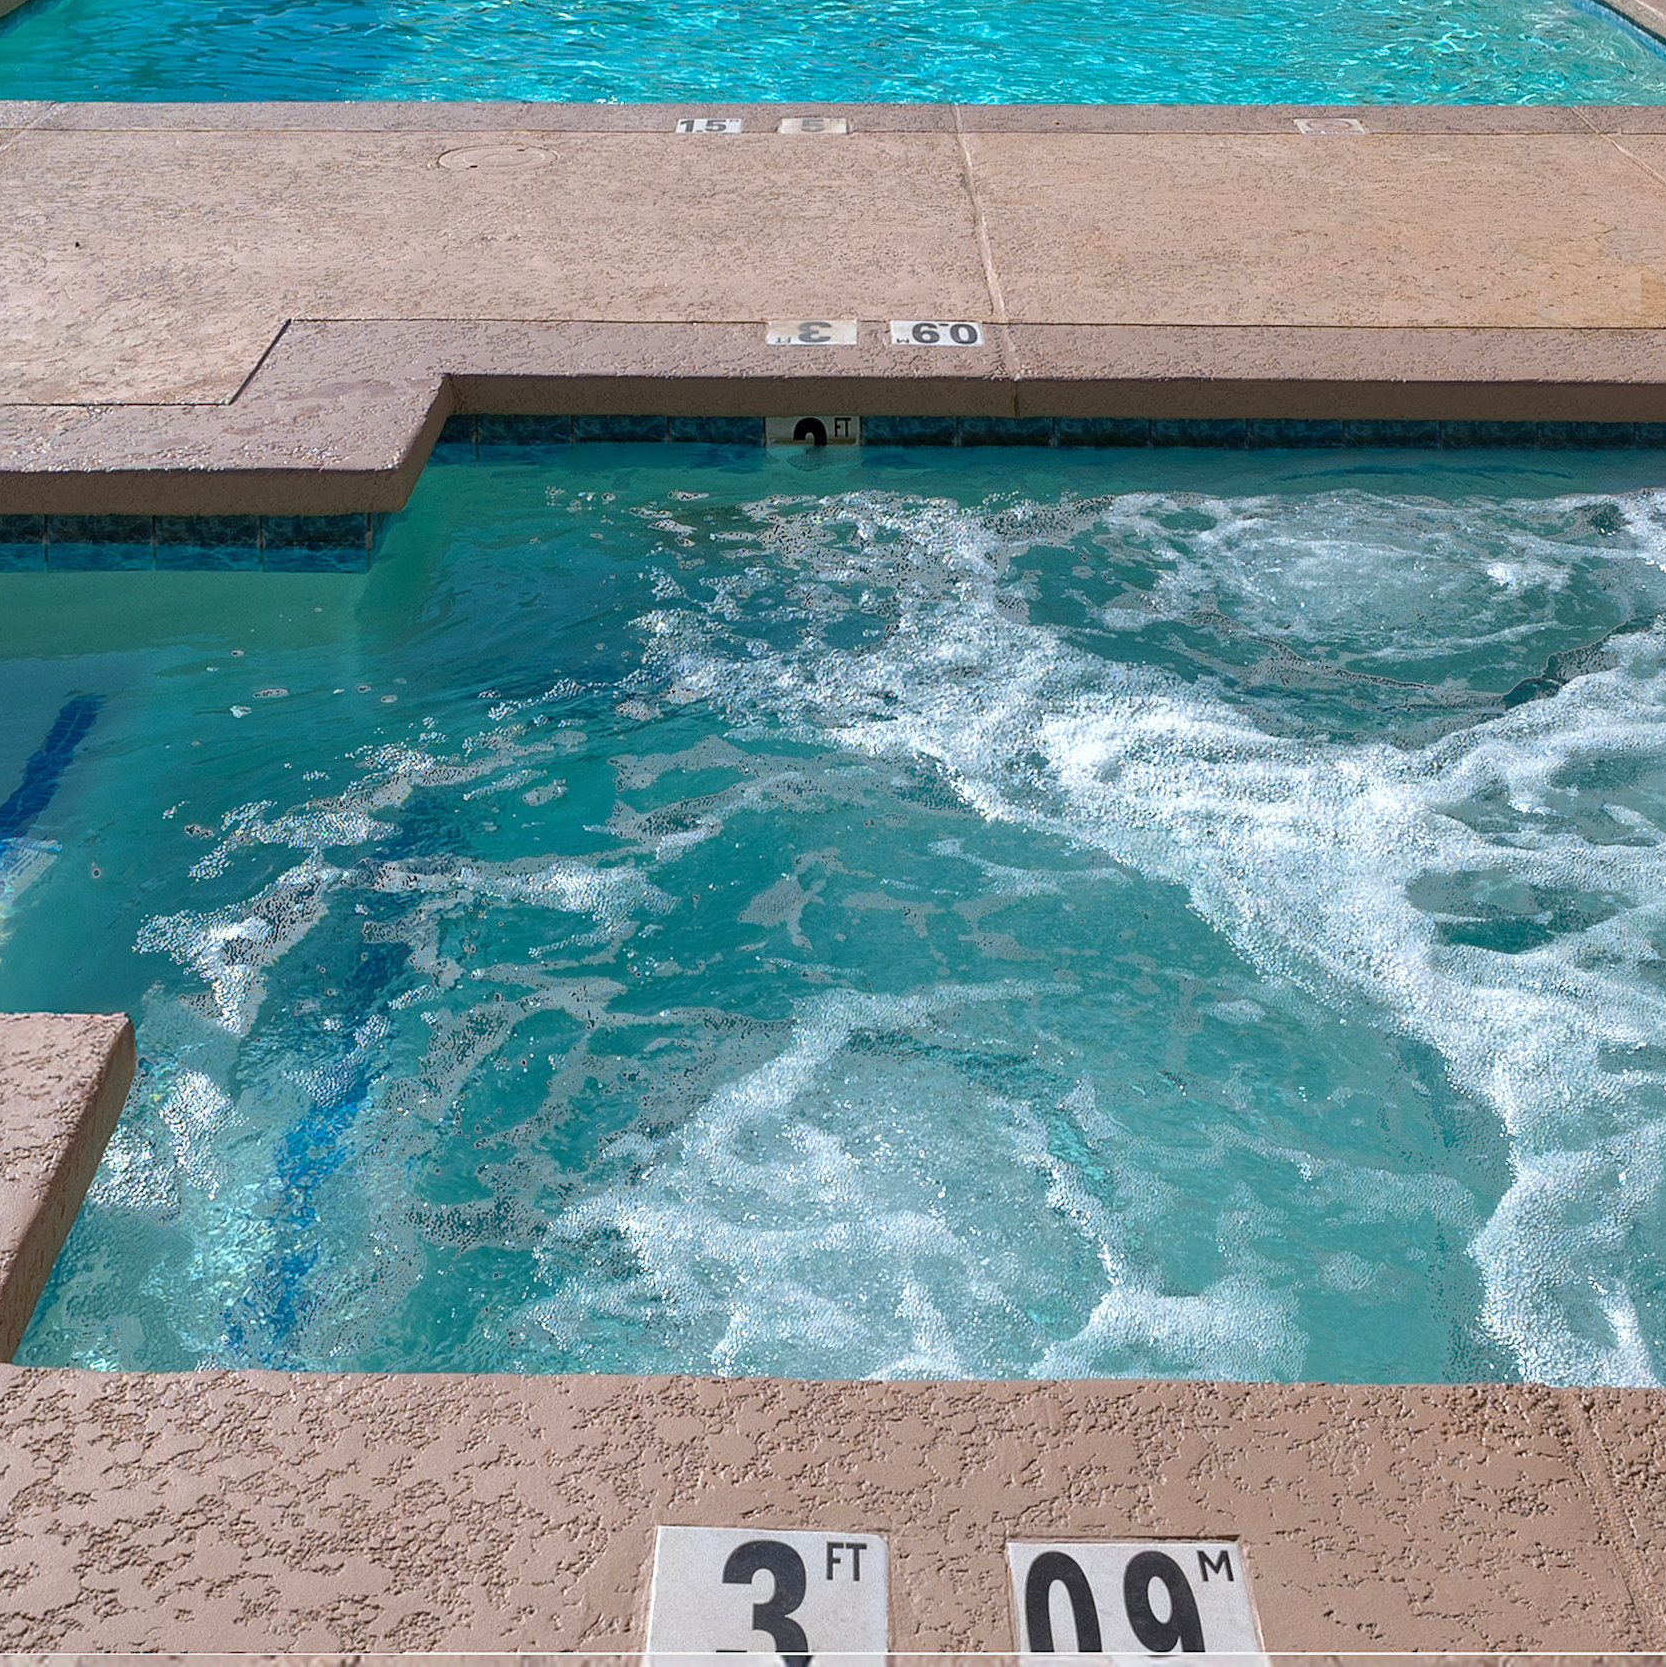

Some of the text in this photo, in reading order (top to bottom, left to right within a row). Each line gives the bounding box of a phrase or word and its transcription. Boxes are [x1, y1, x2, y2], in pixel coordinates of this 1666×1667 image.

[680, 119, 727, 132] 1.5
[801, 119, 825, 132] 5
[798, 321, 832, 343] 3
[912, 322, 978, 344] 0.9
[834, 417, 852, 438] FT
[1196, 1550, 1235, 1582] M
[722, 1539, 867, 1667] 3 FT
